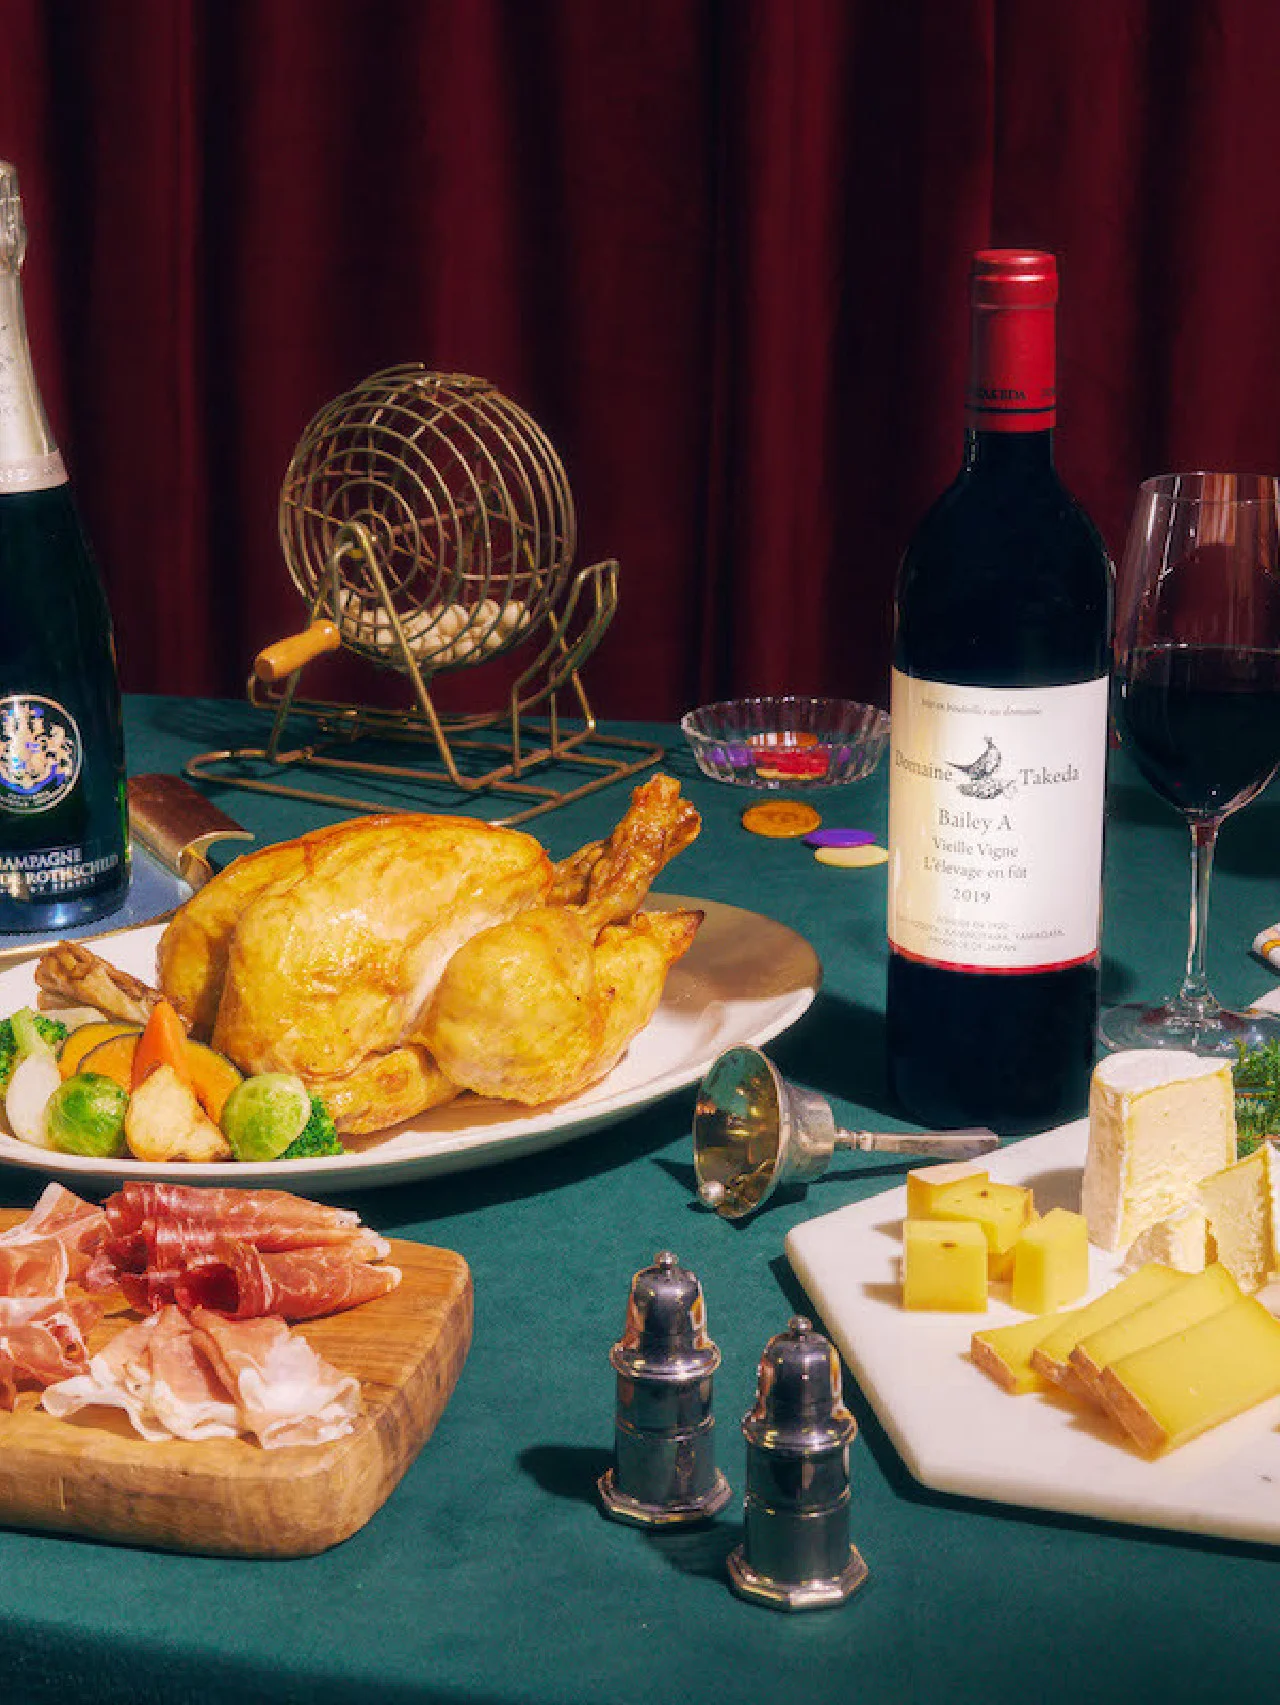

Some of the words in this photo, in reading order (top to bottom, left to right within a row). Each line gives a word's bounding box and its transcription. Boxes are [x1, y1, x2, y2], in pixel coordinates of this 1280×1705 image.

[895, 750, 953, 781] Domaine
[1019, 764, 1079, 785] Takeda
[938, 807, 992, 836] Bailey
[997, 814, 1012, 831] A
[932, 837, 973, 856] Vieille
[977, 844, 1018, 861] Vigne
[987, 867, 1003, 878] en
[952, 888, 991, 904] 2019
